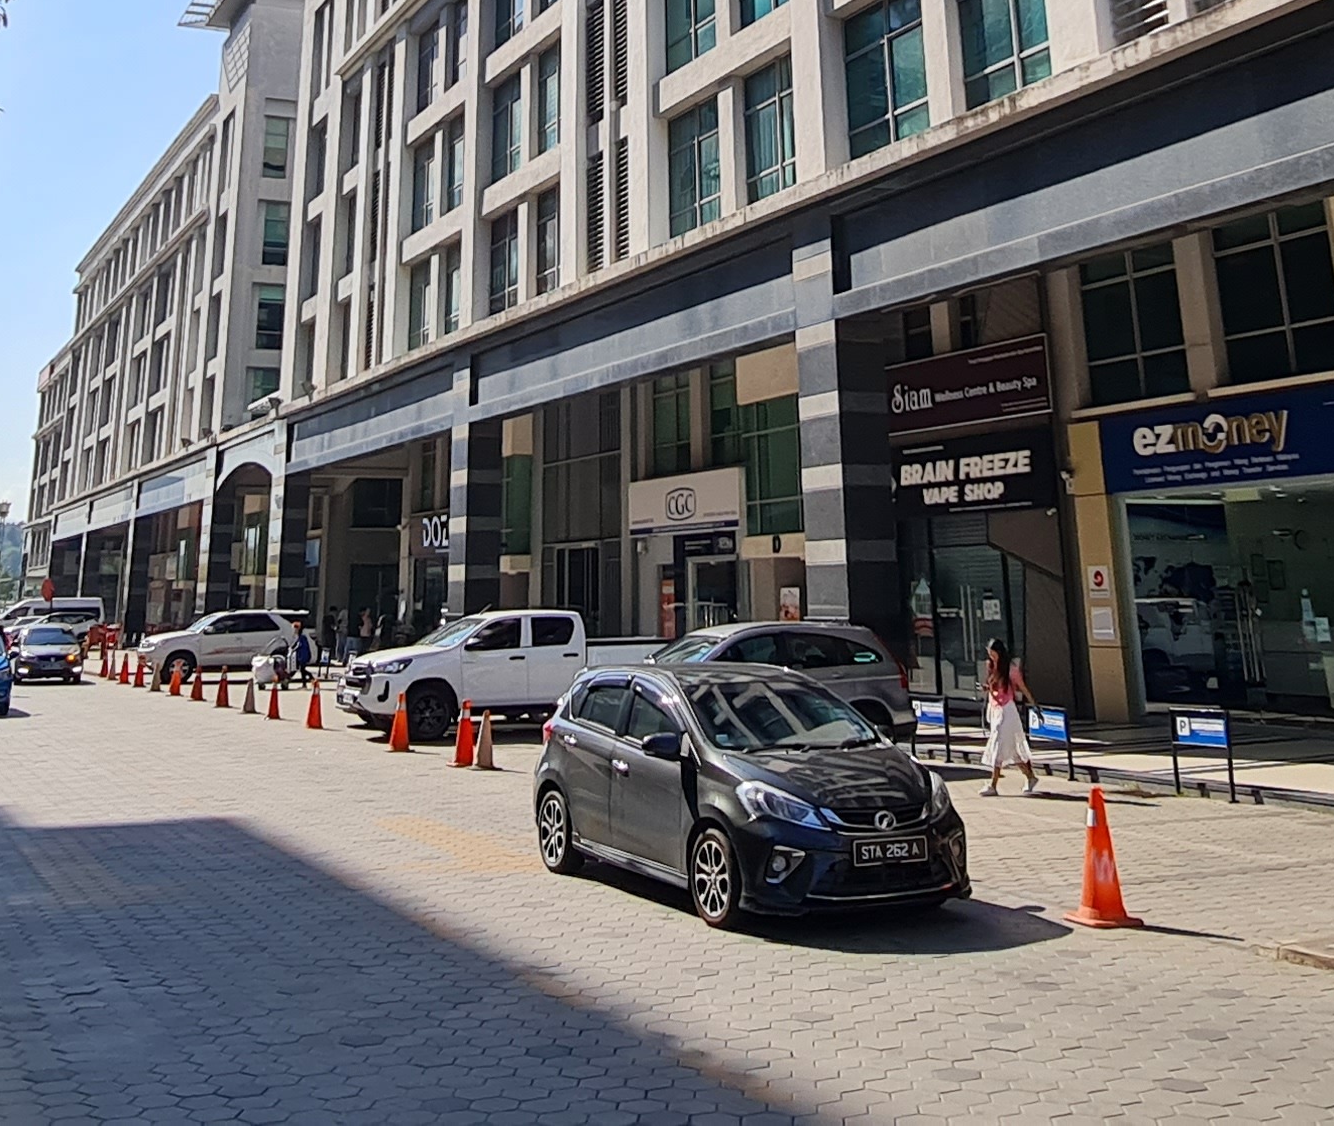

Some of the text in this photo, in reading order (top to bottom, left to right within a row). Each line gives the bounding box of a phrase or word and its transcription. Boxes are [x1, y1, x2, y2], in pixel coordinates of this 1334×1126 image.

[891, 384, 933, 414] Siam
[965, 384, 987, 398] Centre
[988, 382, 995, 394] &
[996, 378, 1022, 393] Beauty
[1022, 376, 1037, 389] Spa
[1133, 410, 1288, 456] ezmoney
[900, 449, 1031, 486] BRAIN FREEZE
[668, 493, 693, 515] CGC
[923, 481, 1005, 505] VAPE SHOP
[861, 841, 920, 860] STA 262 A
